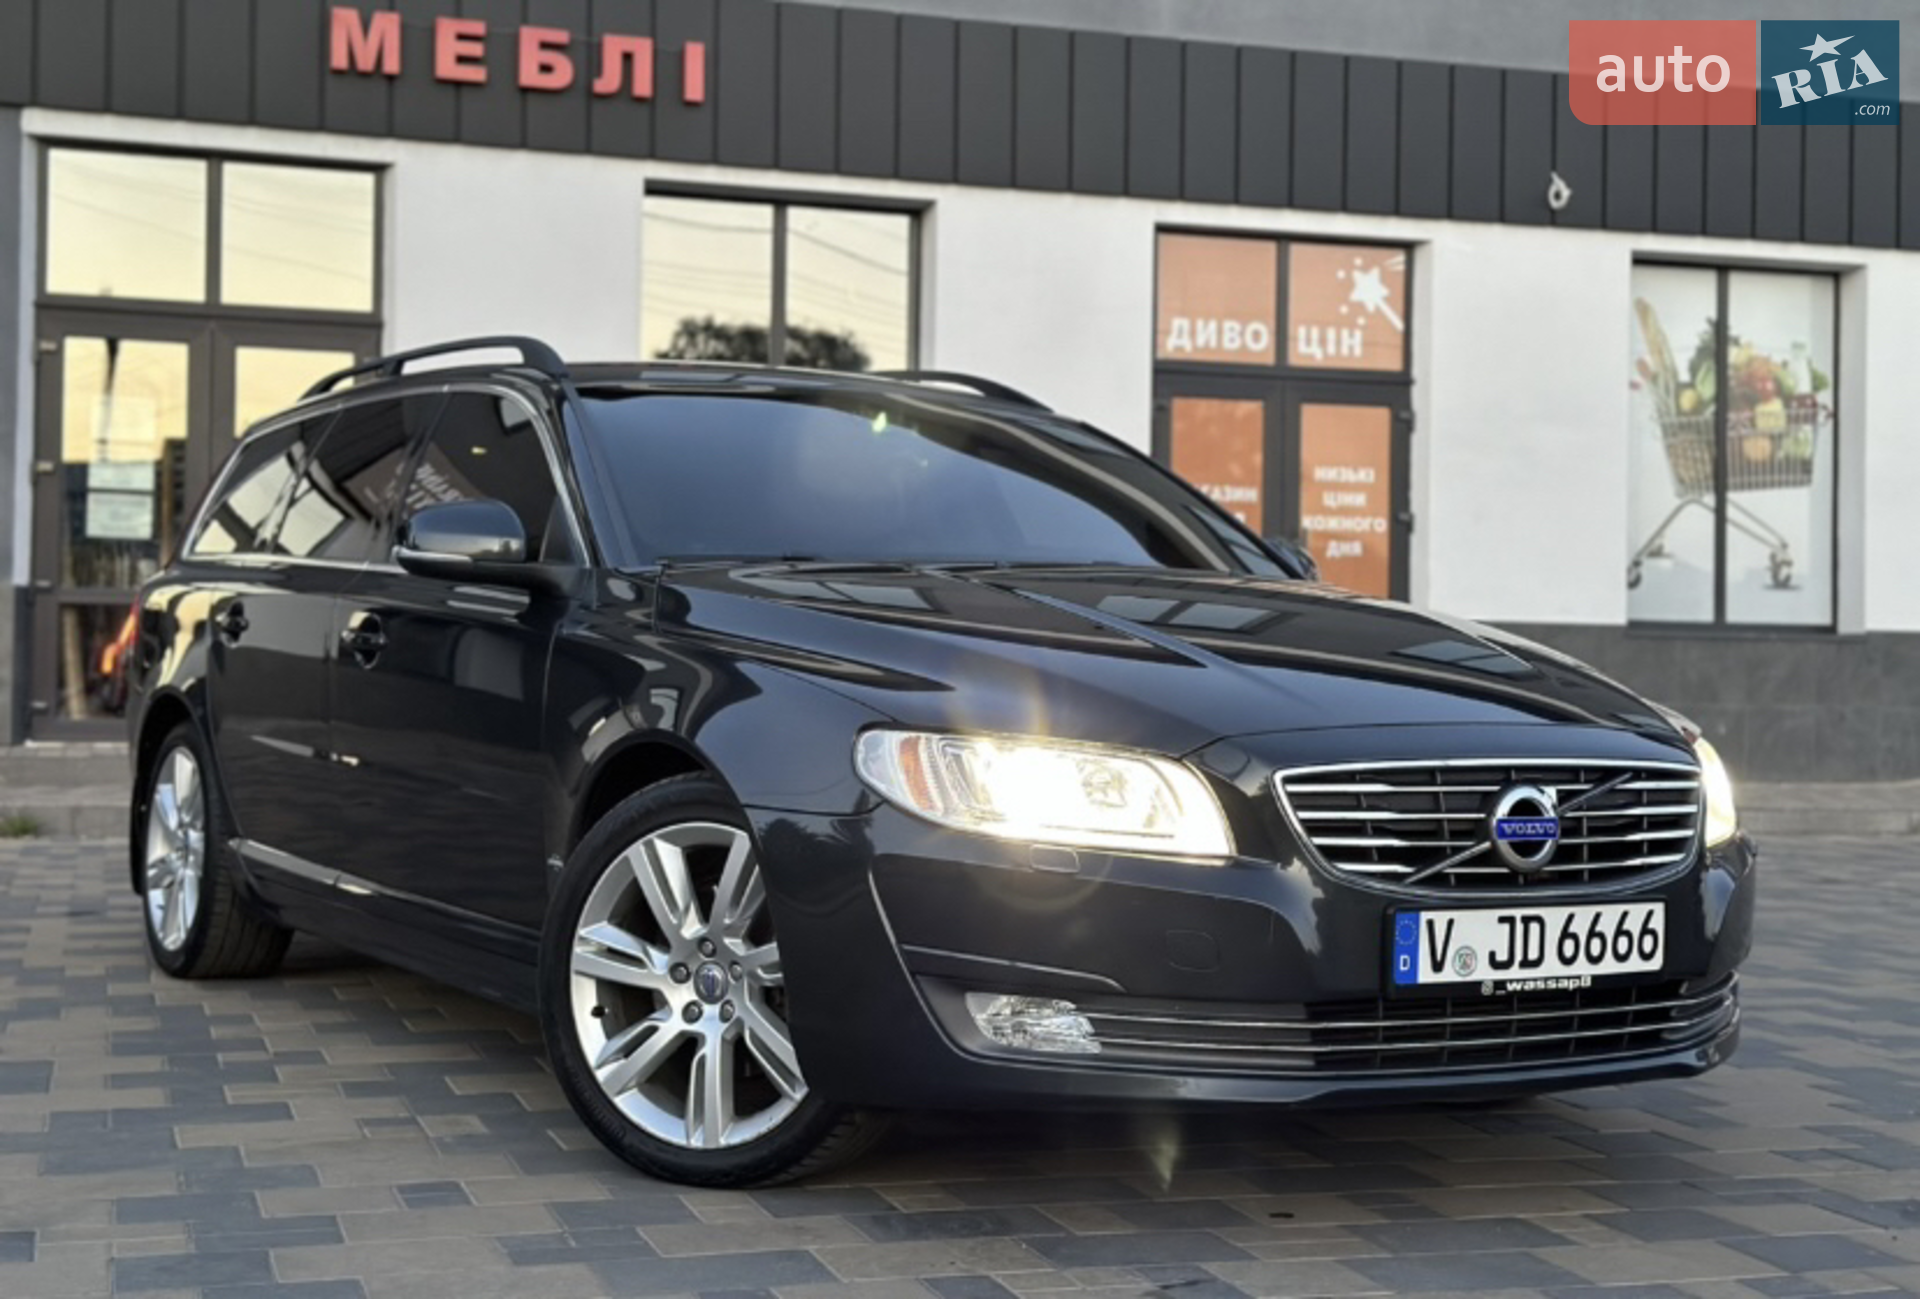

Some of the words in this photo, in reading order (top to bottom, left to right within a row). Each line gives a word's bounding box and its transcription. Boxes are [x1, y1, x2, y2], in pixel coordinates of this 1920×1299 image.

[330, 6, 706, 104] МЕБЛІ
[1166, 317, 1270, 354] ДИВО
[1297, 325, 1364, 360] ЦІН
[1313, 466, 1376, 484] НИЗЬКІ
[1322, 491, 1368, 510] ЦІНИ
[1302, 514, 1388, 534] КОЖНОГО
[1325, 540, 1364, 559] ДНЯ
[1500, 822, 1557, 836] VOLVO
[1426, 918, 1455, 974] V
[1488, 915, 1546, 971] JD
[1556, 908, 1660, 966] 6666
[1400, 955, 1411, 971] D
